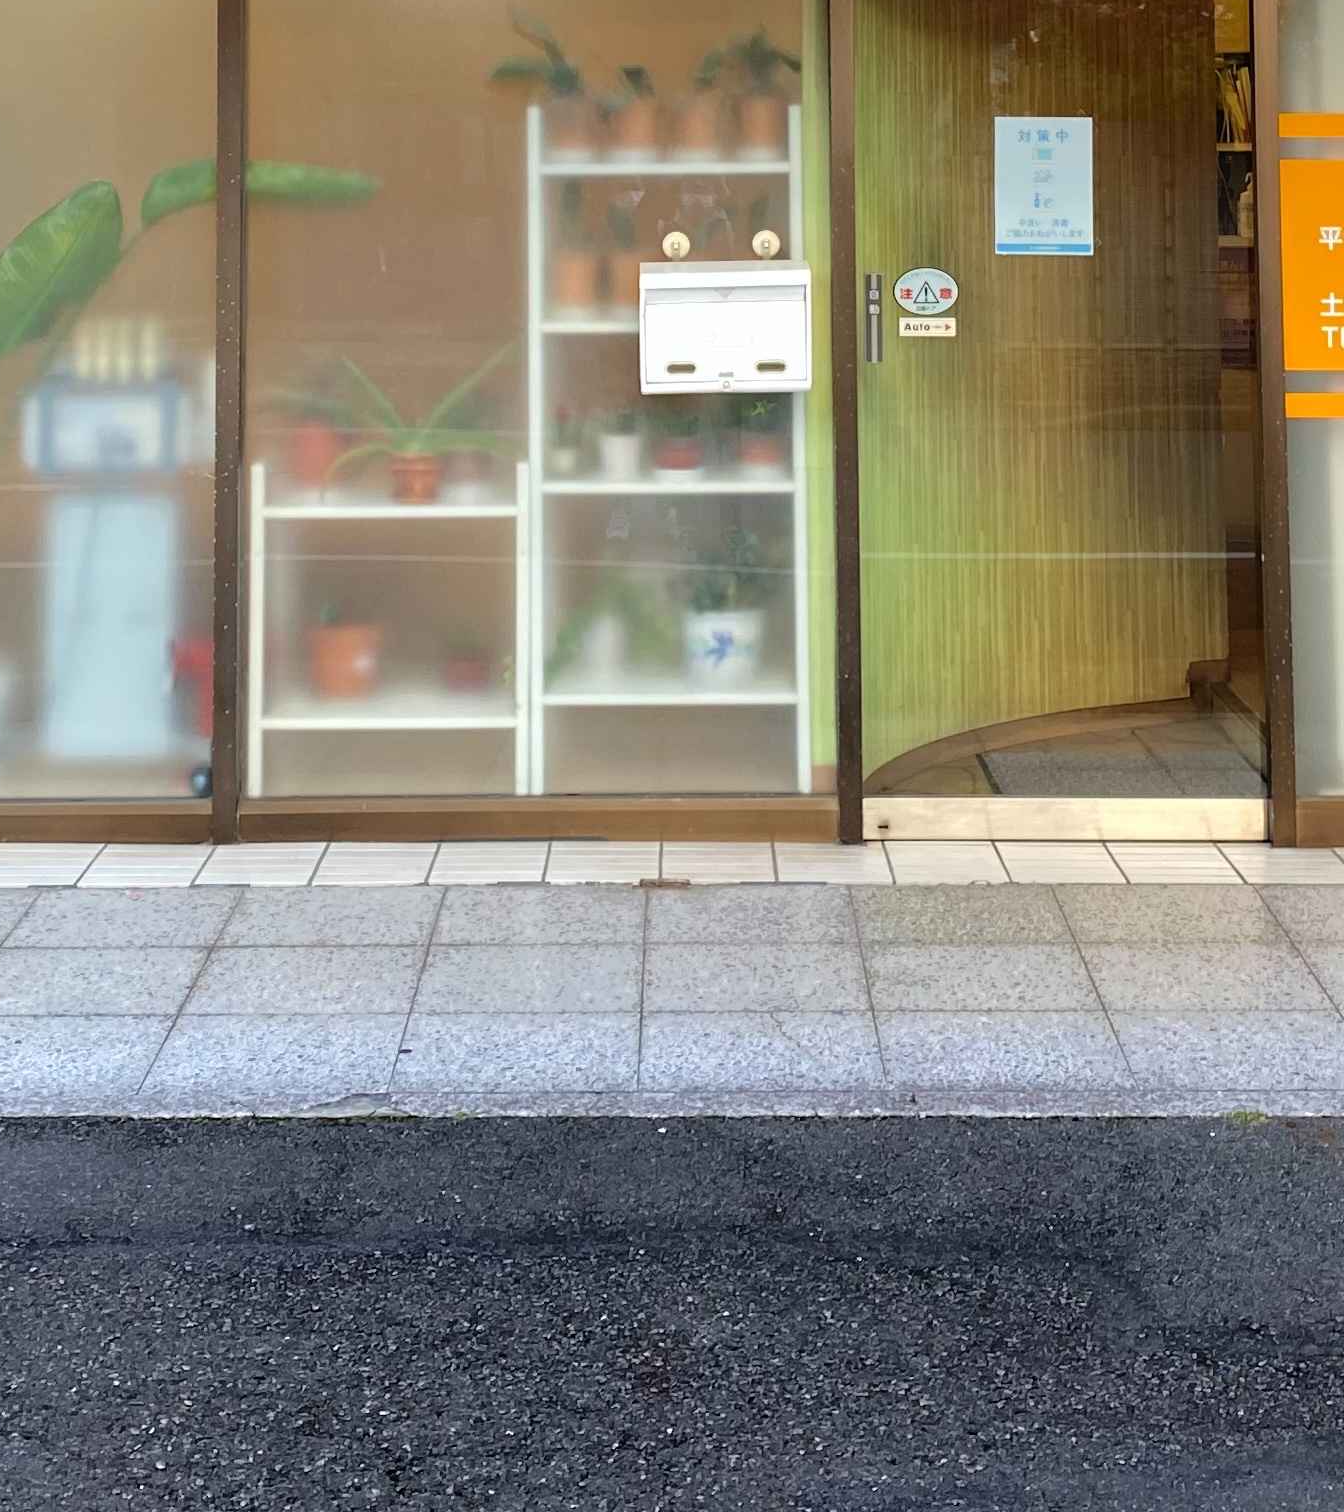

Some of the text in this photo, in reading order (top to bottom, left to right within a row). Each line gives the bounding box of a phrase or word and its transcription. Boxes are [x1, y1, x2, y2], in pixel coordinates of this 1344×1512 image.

[1017, 128, 1069, 144] 対策中
[904, 323, 930, 331] Auto
